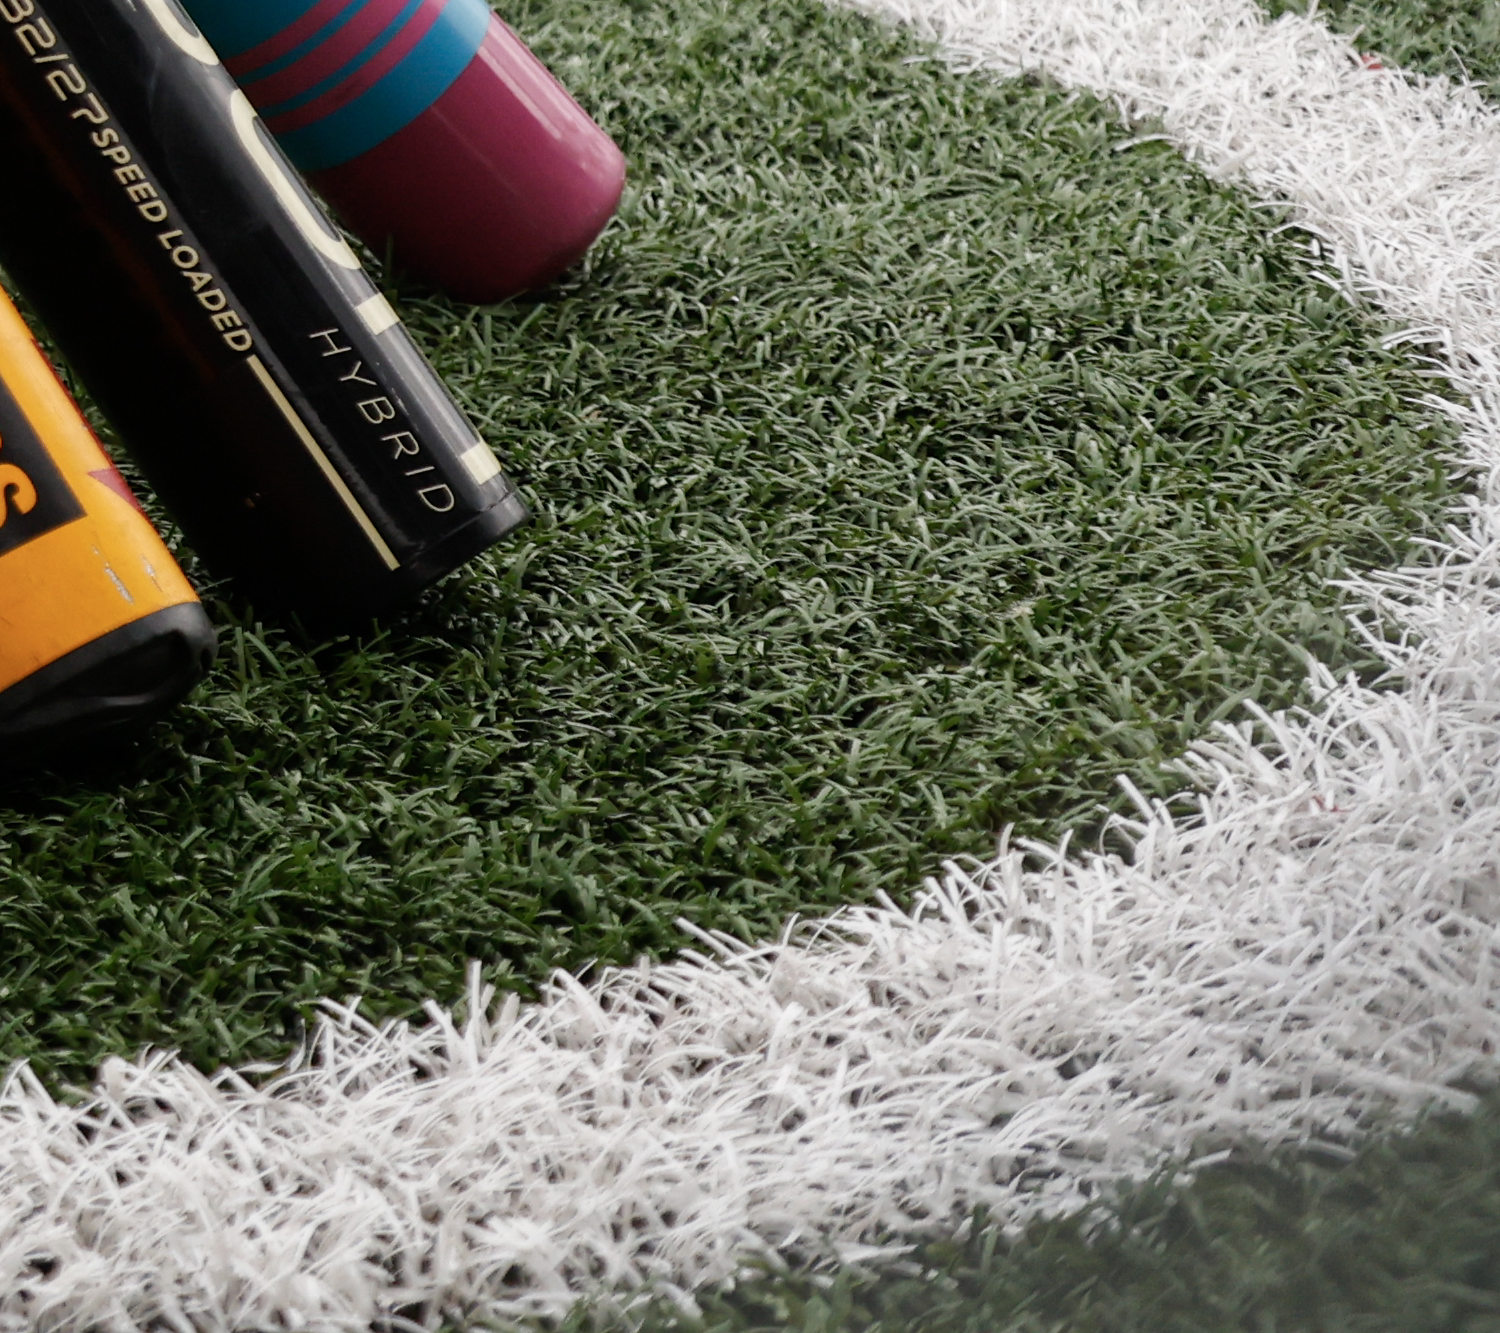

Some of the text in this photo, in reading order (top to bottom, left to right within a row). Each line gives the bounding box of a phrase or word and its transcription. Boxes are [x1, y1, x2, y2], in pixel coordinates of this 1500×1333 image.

[87, 121, 173, 228] SPEED
[152, 221, 261, 358] LOADED
[308, 326, 457, 516] HYBRID
